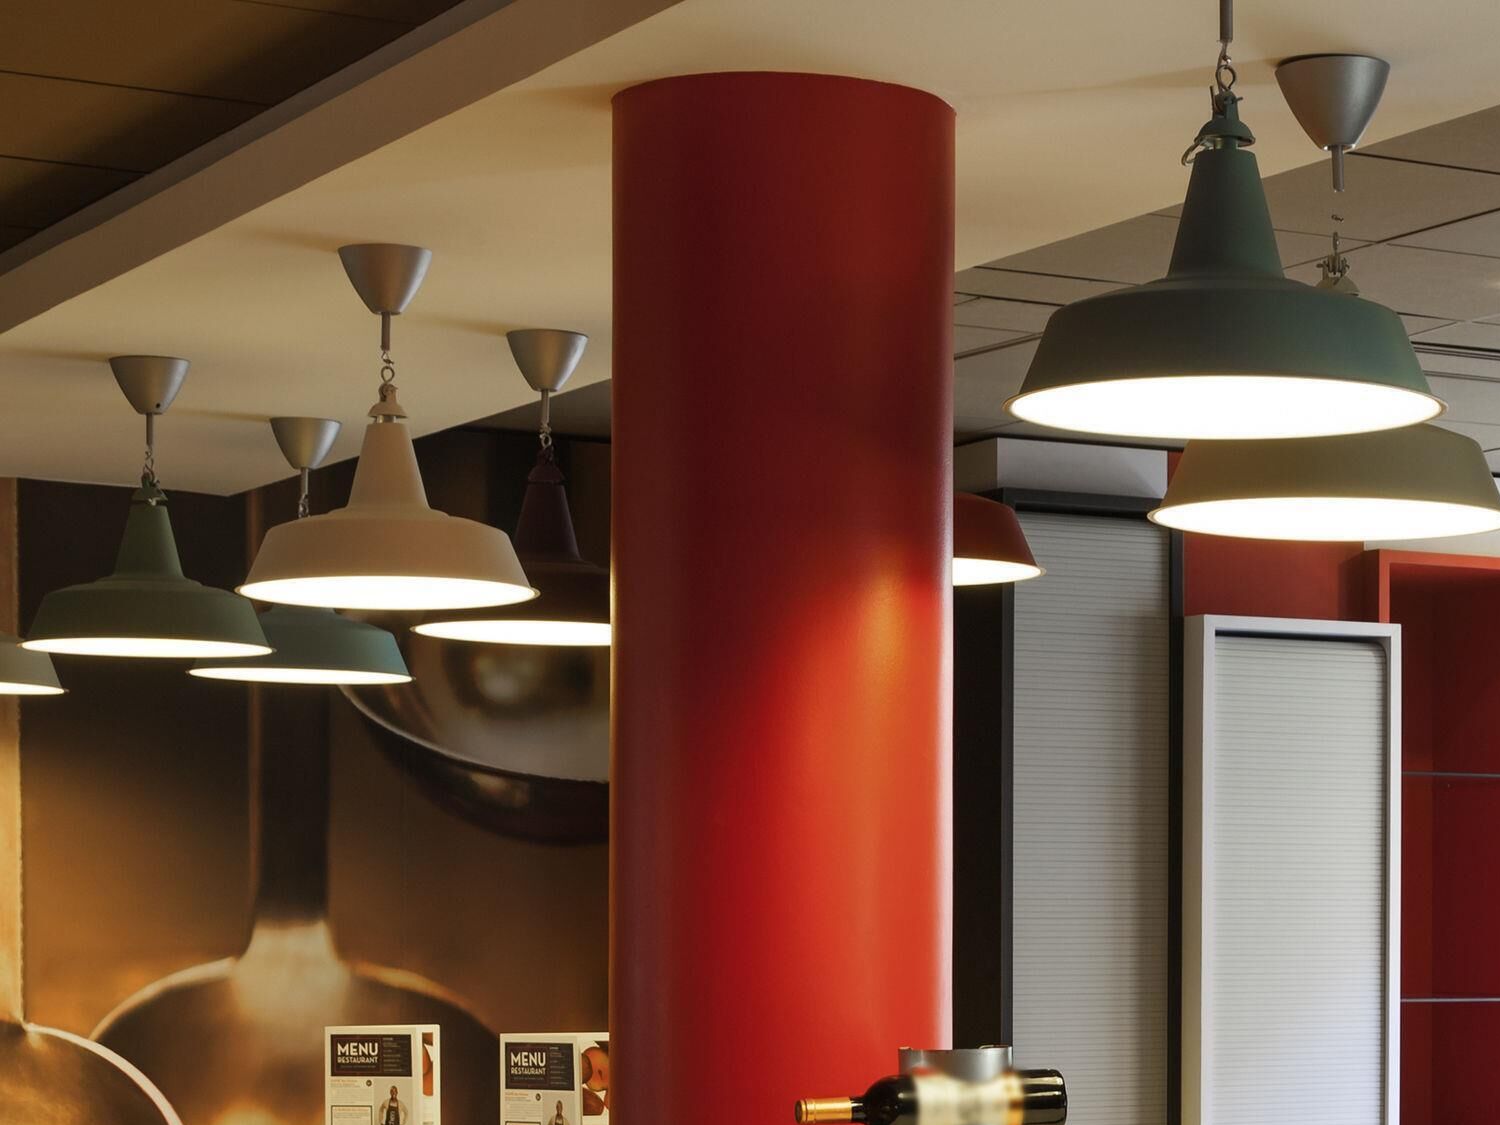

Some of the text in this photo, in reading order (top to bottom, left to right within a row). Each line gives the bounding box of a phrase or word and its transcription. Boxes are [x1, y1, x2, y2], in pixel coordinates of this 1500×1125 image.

[337, 1042, 379, 1056] MENU
[337, 1056, 379, 1064] RESTAURANT
[510, 1051, 546, 1067] MENU
[510, 1067, 546, 1075] RESTAURANT
